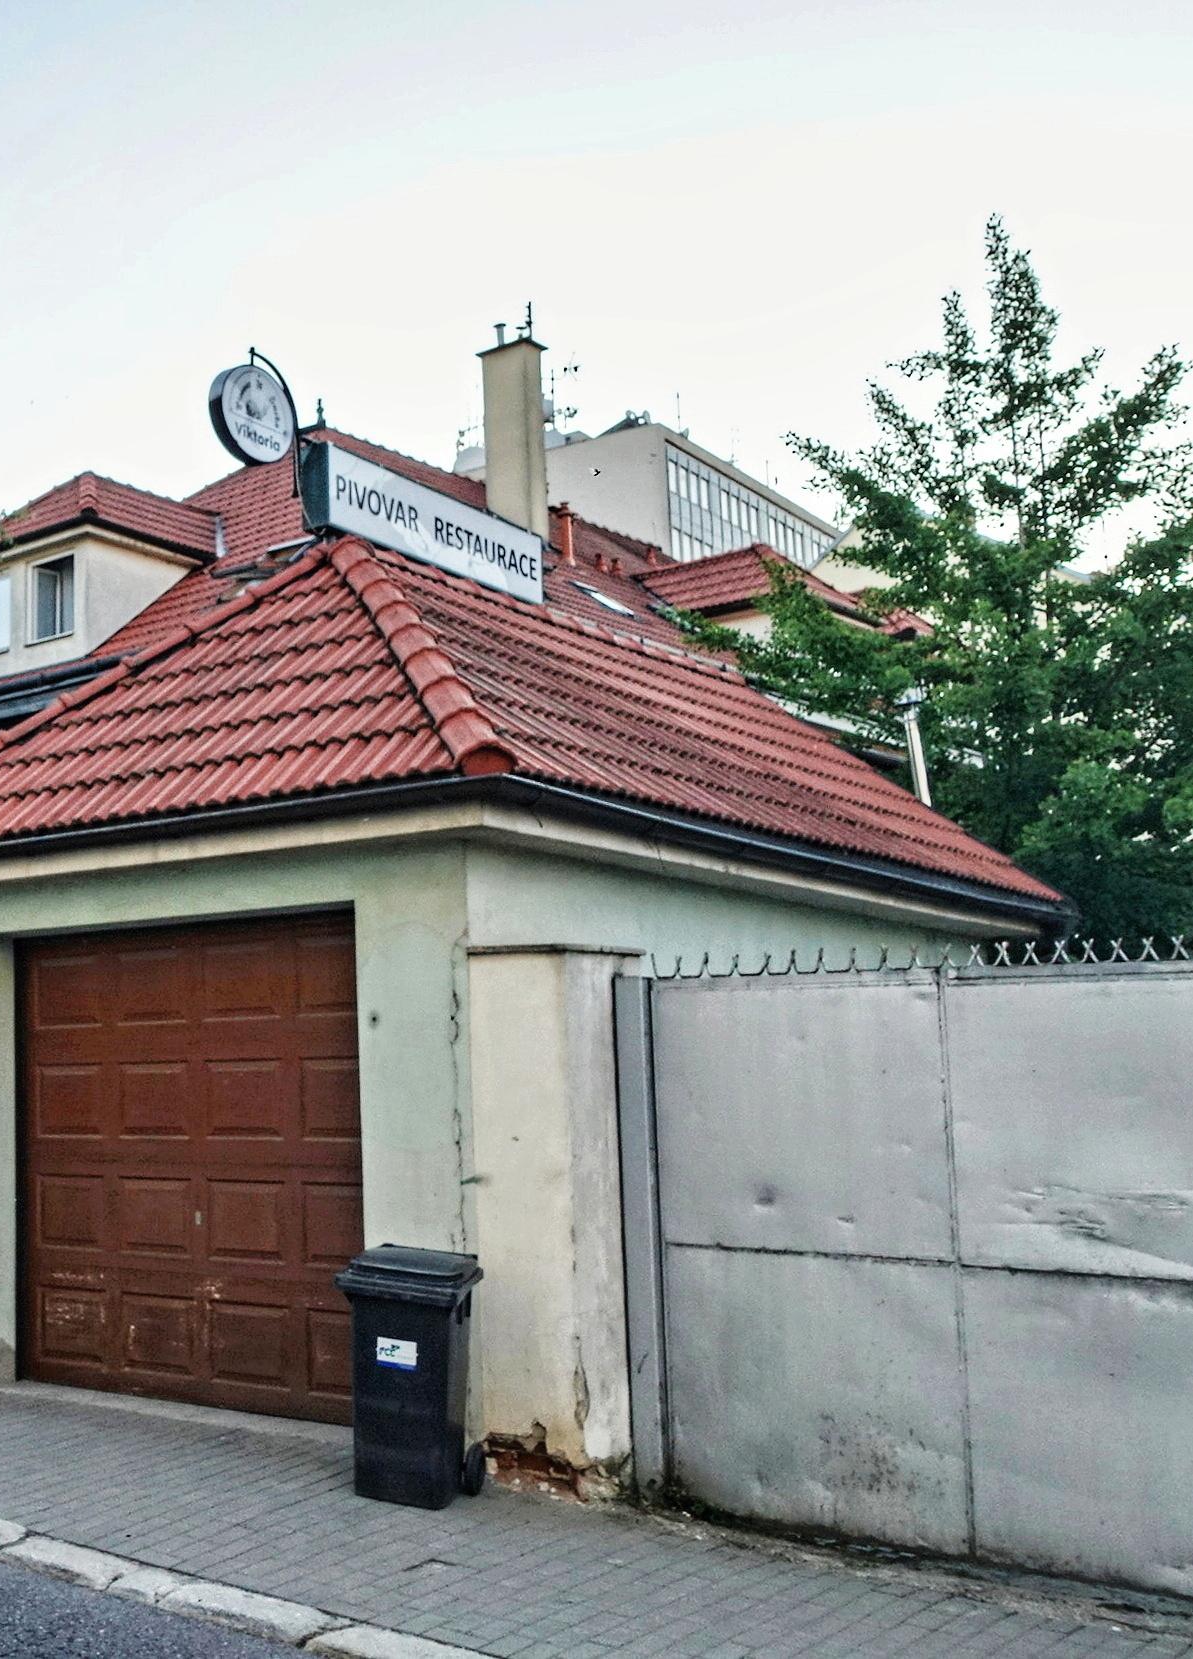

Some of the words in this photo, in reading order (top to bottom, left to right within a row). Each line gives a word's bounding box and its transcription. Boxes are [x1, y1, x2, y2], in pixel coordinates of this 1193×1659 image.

[236, 422, 280, 452] Viktoria
[336, 475, 420, 533] PIVOVAR
[435, 517, 537, 581] RESTAURACE
